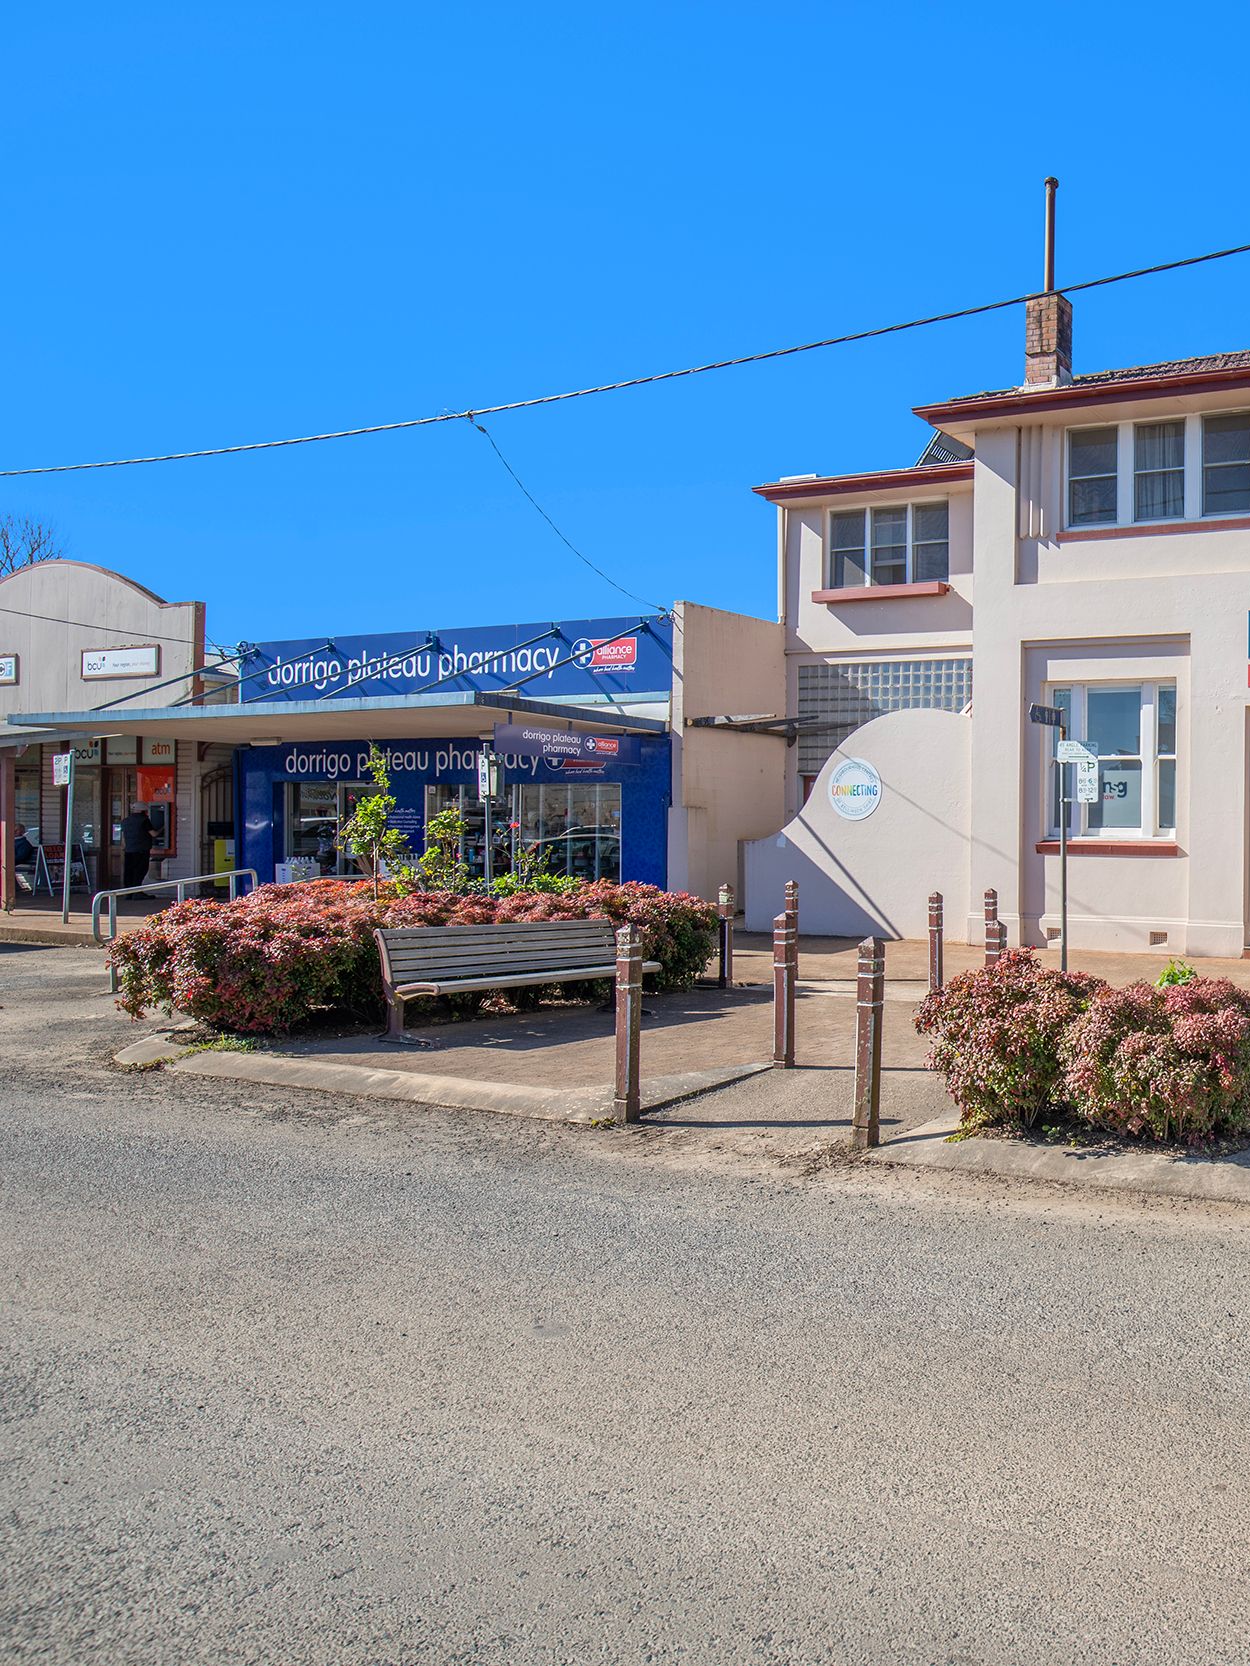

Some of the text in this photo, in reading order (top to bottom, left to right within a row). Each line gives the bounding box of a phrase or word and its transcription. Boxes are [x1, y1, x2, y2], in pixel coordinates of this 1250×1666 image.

[596, 644, 632, 656] alliance
[87, 662, 102, 671] bcu
[268, 644, 560, 690] dorrigo plateau pharmacy
[522, 729, 581, 744] dorrigo plateau
[151, 742, 171, 756] atm
[542, 743, 581, 757] pharmacy
[285, 747, 351, 780] dorrigo
[1103, 780, 1128, 798] nsg
